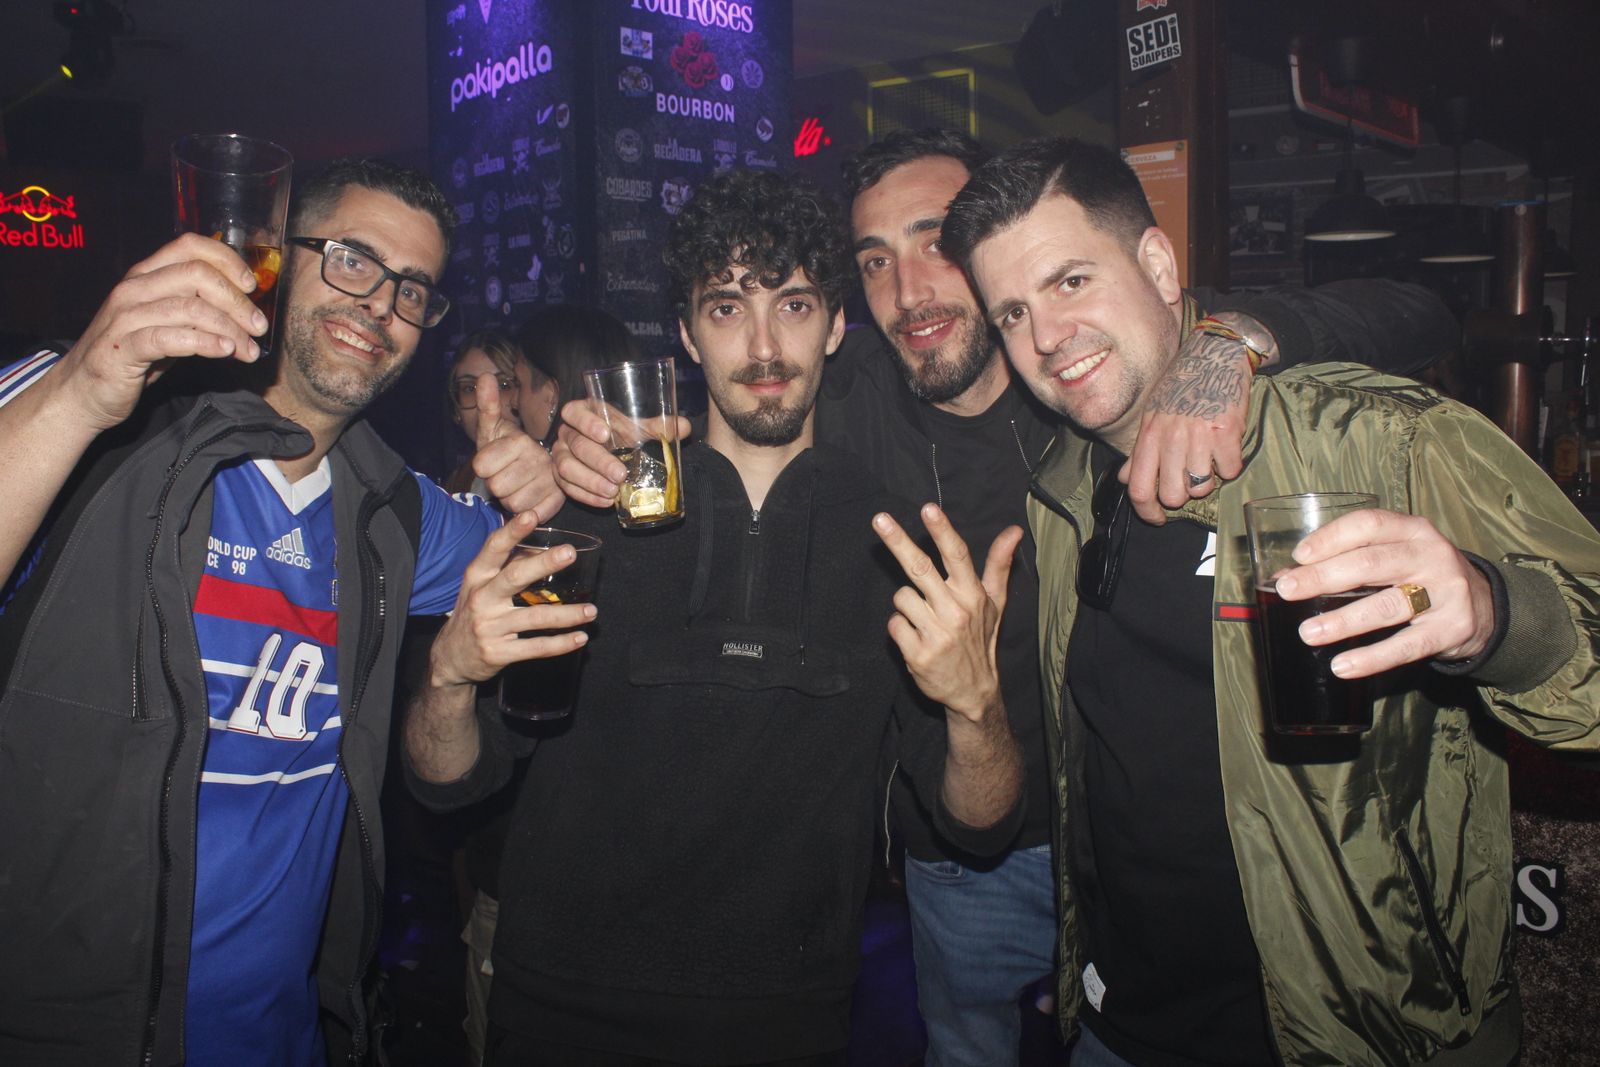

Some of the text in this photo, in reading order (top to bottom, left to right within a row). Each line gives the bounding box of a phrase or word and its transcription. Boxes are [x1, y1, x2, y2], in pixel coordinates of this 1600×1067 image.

[451, 41, 553, 113] pakipalla
[656, 92, 735, 124] BOURBON
[0, 221, 85, 249] Red Bull
[233, 544, 257, 561] CUP
[266, 546, 312, 570] adidas
[232, 560, 247, 576] 98
[723, 642, 763, 652] HOLLISTER
[226, 633, 325, 741] 10
